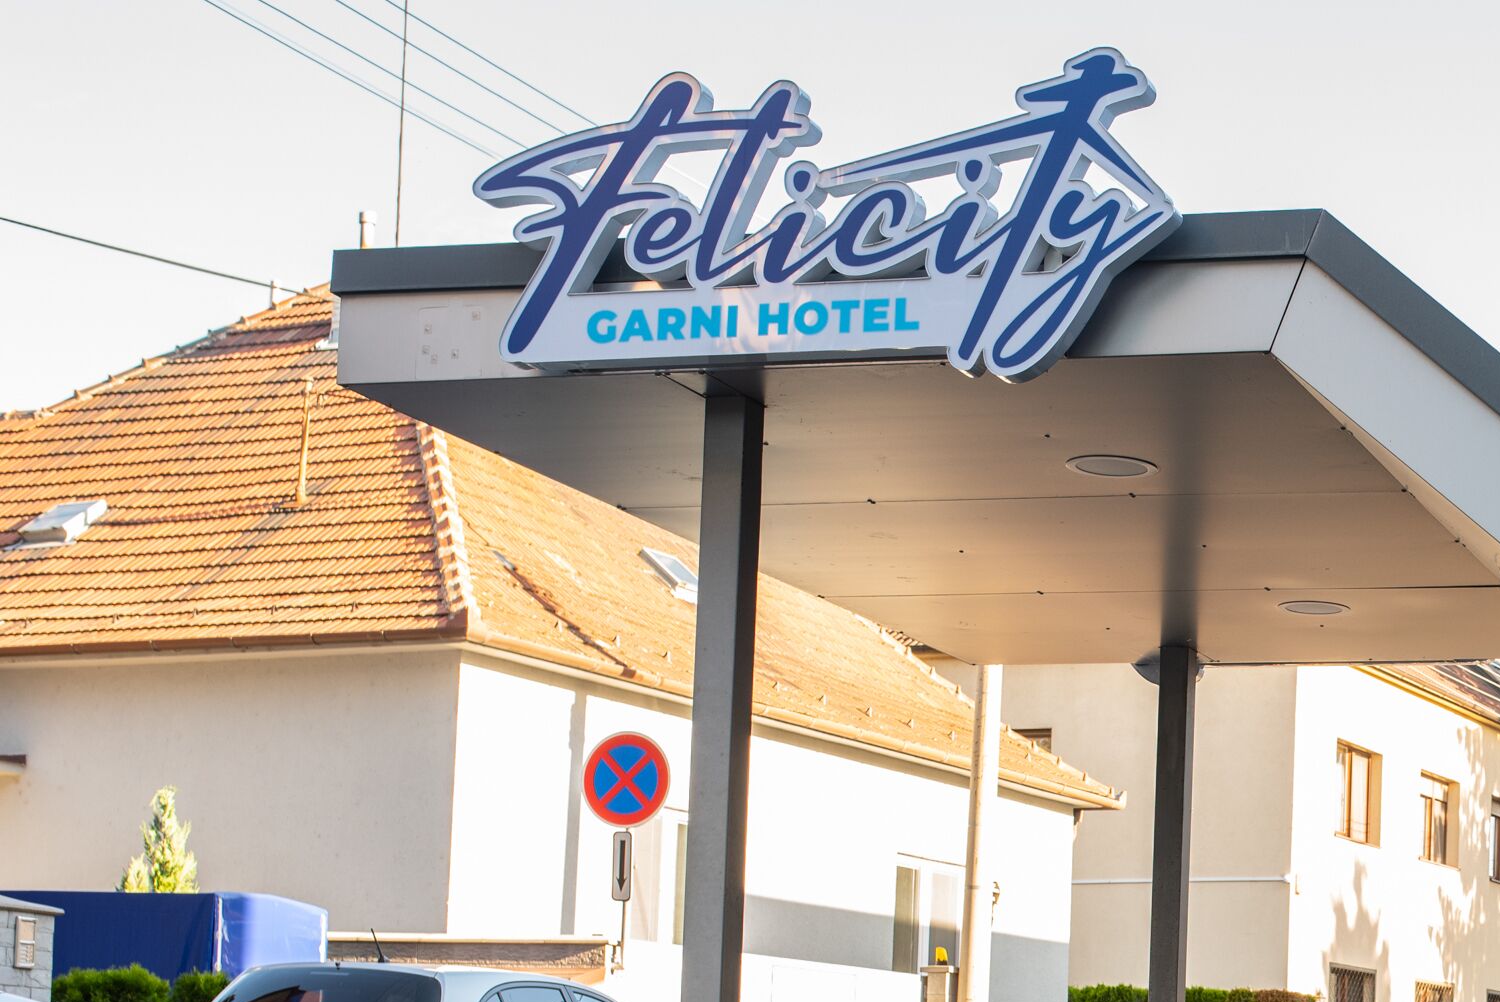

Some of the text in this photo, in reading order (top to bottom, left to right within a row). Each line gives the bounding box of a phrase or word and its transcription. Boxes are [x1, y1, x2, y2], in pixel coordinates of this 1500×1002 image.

[480, 54, 1167, 368] Felicity
[586, 297, 920, 344] GARNI HOTEL
